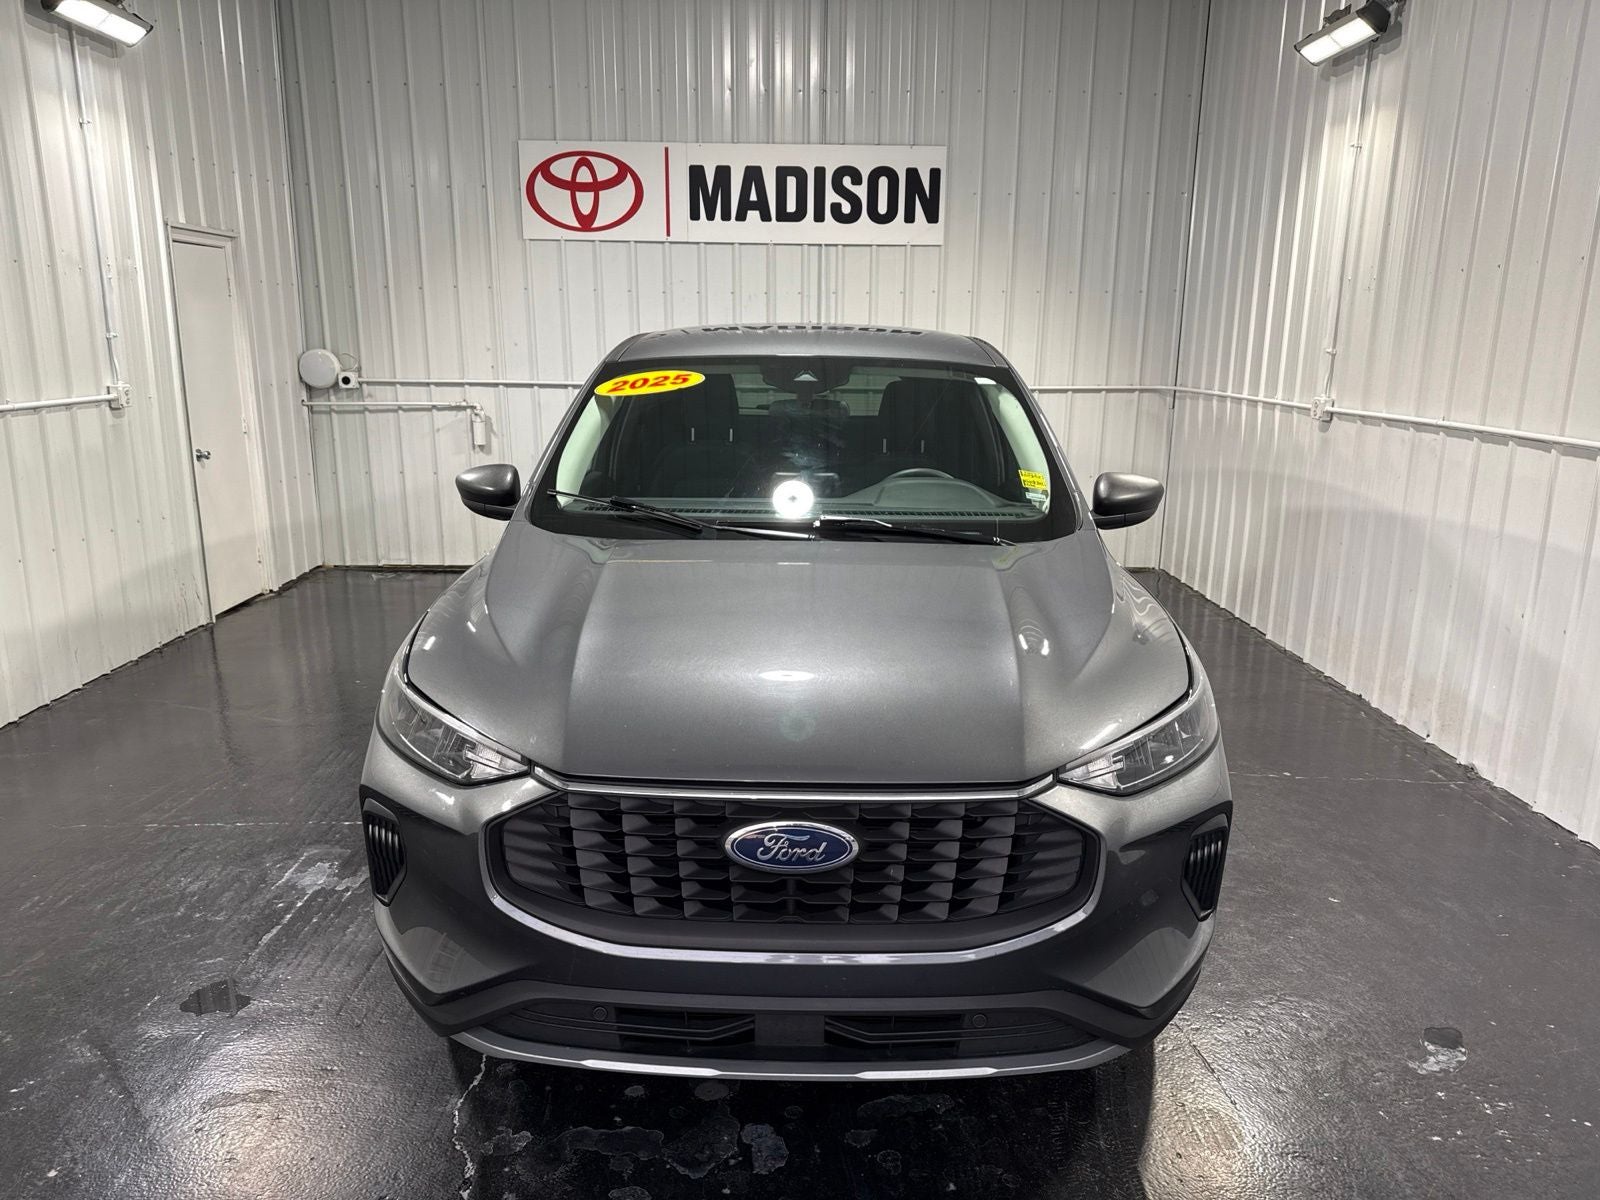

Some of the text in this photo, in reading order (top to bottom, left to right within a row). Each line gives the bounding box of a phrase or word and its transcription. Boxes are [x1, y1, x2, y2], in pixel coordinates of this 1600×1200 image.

[688, 164, 941, 225] MADISON
[606, 373, 692, 394] 2025
[756, 832, 828, 862] Ford
